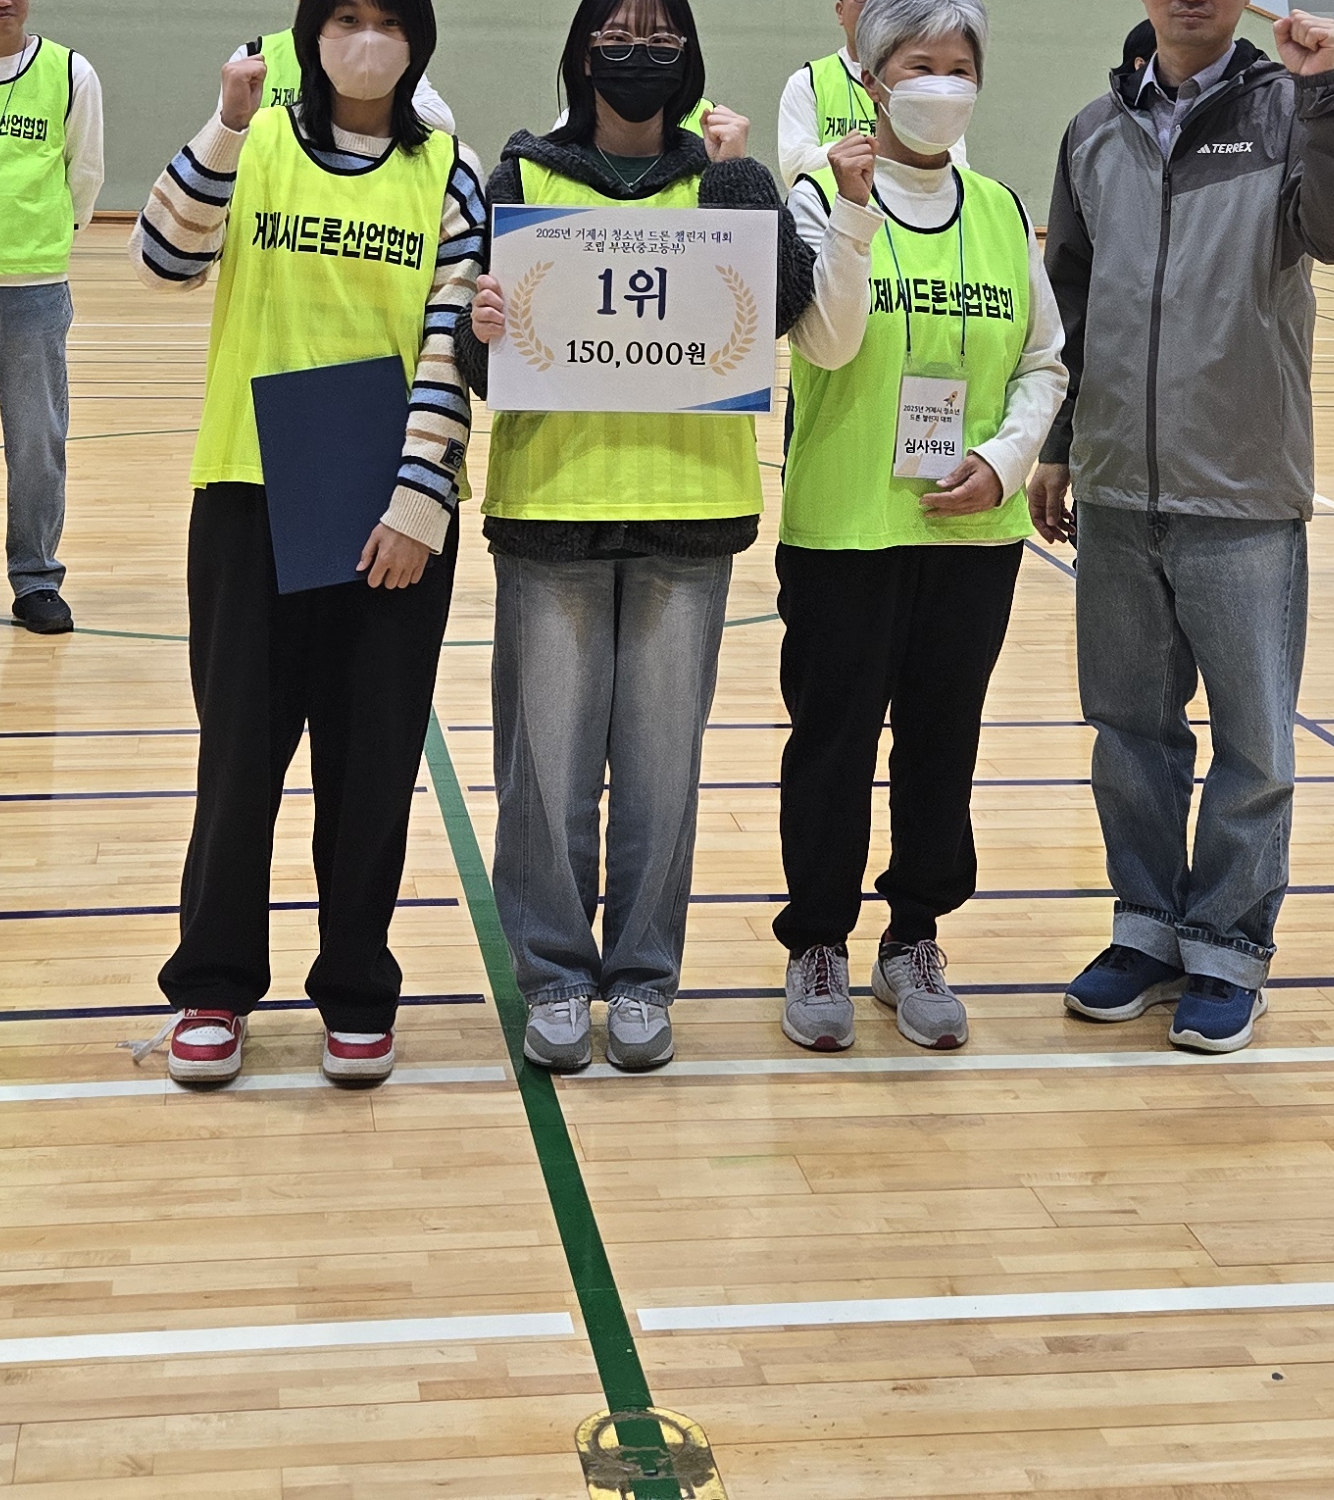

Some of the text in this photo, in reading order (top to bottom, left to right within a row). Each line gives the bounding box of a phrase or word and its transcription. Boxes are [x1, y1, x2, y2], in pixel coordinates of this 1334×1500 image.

[1211, 141, 1254, 154] TERREX
[251, 210, 425, 271] 거제시드론산업협회
[535, 227, 733, 244] 2025년 거제시 청소년 드론 챌린지 대회
[582, 241, 605, 253] 조립
[596, 266, 668, 321] 1위
[868, 276, 1015, 323] 제시드론산업협회
[565, 339, 707, 369] 150,000원
[904, 437, 956, 456] 심사위원
